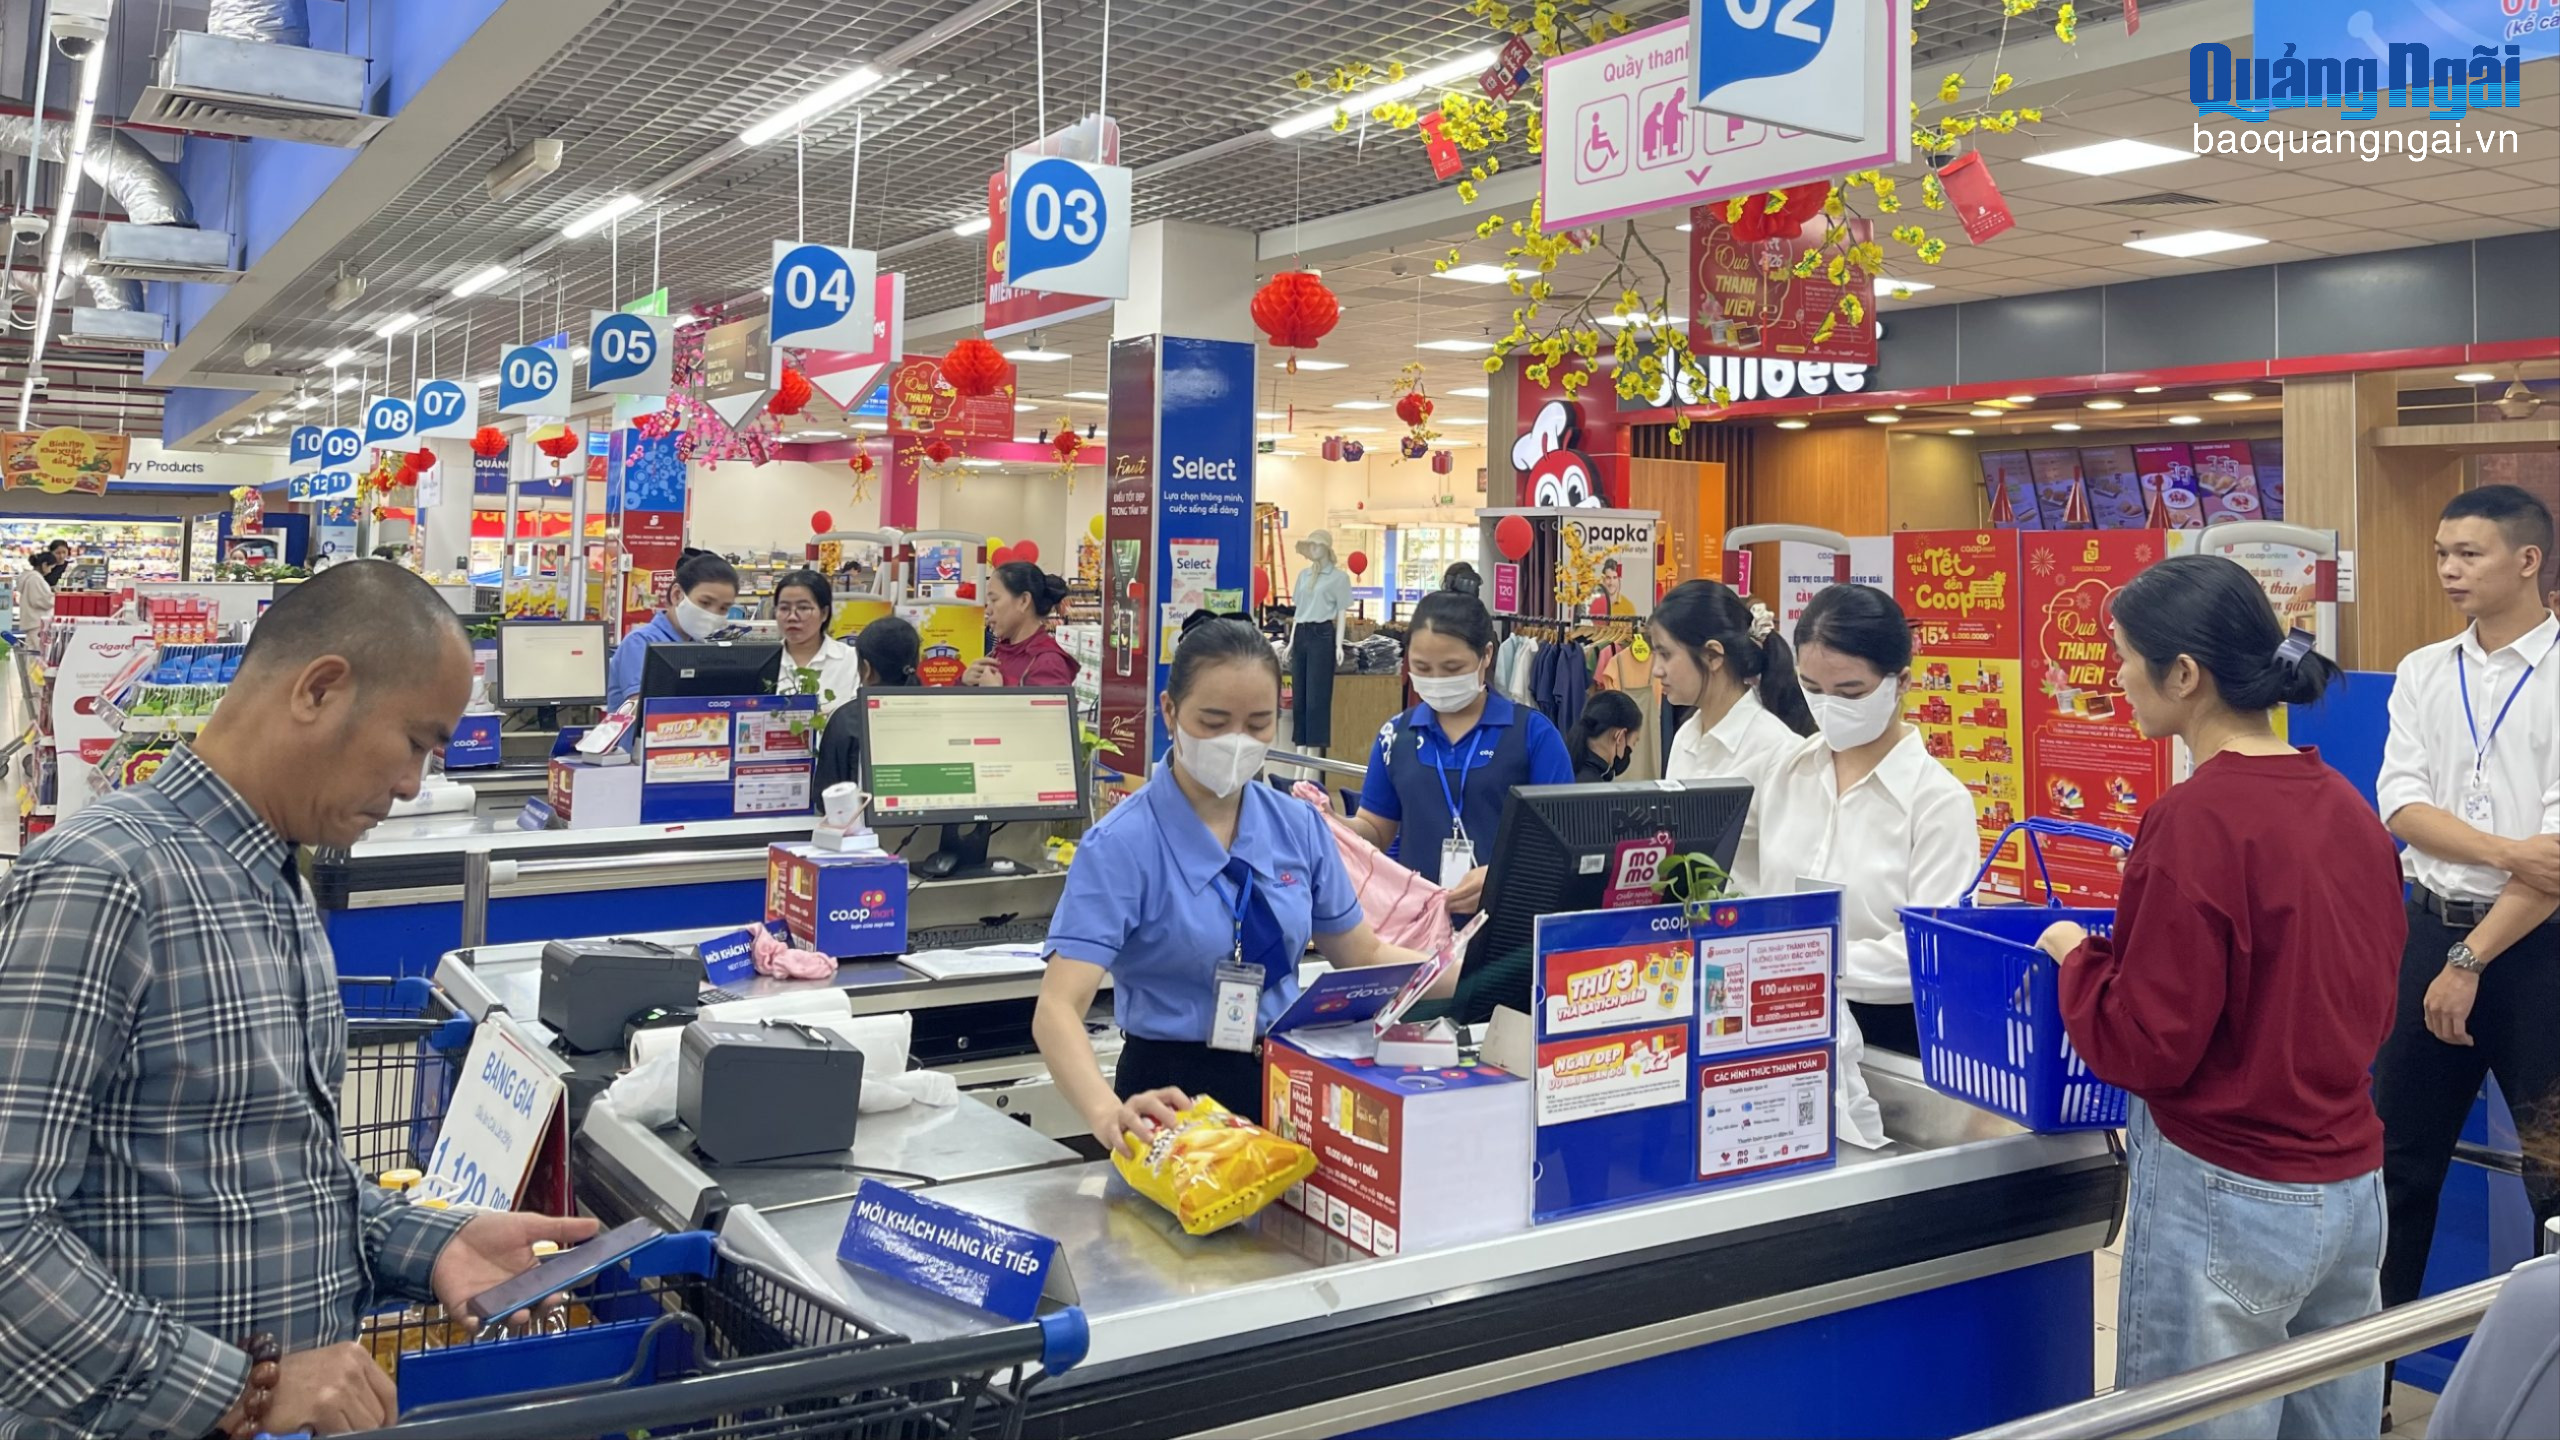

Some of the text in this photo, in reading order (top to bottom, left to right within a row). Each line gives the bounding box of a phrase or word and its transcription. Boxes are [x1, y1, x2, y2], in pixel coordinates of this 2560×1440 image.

[2505, 13, 2537, 40] (kể
[1603, 54, 1645, 83] Quầy
[1024, 182, 1098, 245] 03
[1714, 244, 1750, 270] Quà
[785, 264, 850, 313] 04
[1714, 271, 1758, 295] THÀNH
[1723, 296, 1757, 317] VIÊN
[600, 328, 651, 365] 05
[508, 358, 553, 390] 06
[423, 390, 462, 416] 07
[374, 407, 409, 432] 08
[297, 433, 322, 452] 10
[327, 436, 358, 456] 09
[147, 460, 204, 473] Products
[1171, 455, 1238, 482] Select
[313, 478, 328, 491] 12
[330, 475, 346, 487] 11
[1163, 491, 1244, 504] Lựa chọn thông minh,
[1169, 503, 1239, 517] cuộc sống dễ dàng
[1588, 524, 1648, 545] papka
[1176, 557, 1212, 570] Select
[1924, 547, 1976, 577] Tết
[1499, 585, 1513, 597] 120
[1943, 575, 1963, 590] đến
[1210, 598, 1237, 609] Select
[1976, 597, 2006, 610] ngay
[1920, 626, 1950, 645] 15%
[2057, 610, 2098, 639] Quà
[89, 642, 132, 652] Colgate
[2058, 637, 2108, 661] THÀNH
[2067, 662, 2105, 685] VIÊN
[720, 944, 745, 960] KHÁCH
[1571, 960, 1634, 1001] THỨ 3
[1760, 983, 1777, 996] 100
[1713, 1059, 1818, 1082] CÁC HÌNH THỨC THANH TOÁN
[481, 1050, 540, 1120] BẢNG GIÁ
[1292, 1088, 1313, 1106] khách
[884, 1211, 937, 1242] KHÁCH
[936, 1227, 982, 1256] HÀNG
[1005, 1249, 1040, 1277] TIẾP
[956, 1264, 990, 1287] PLEASE
